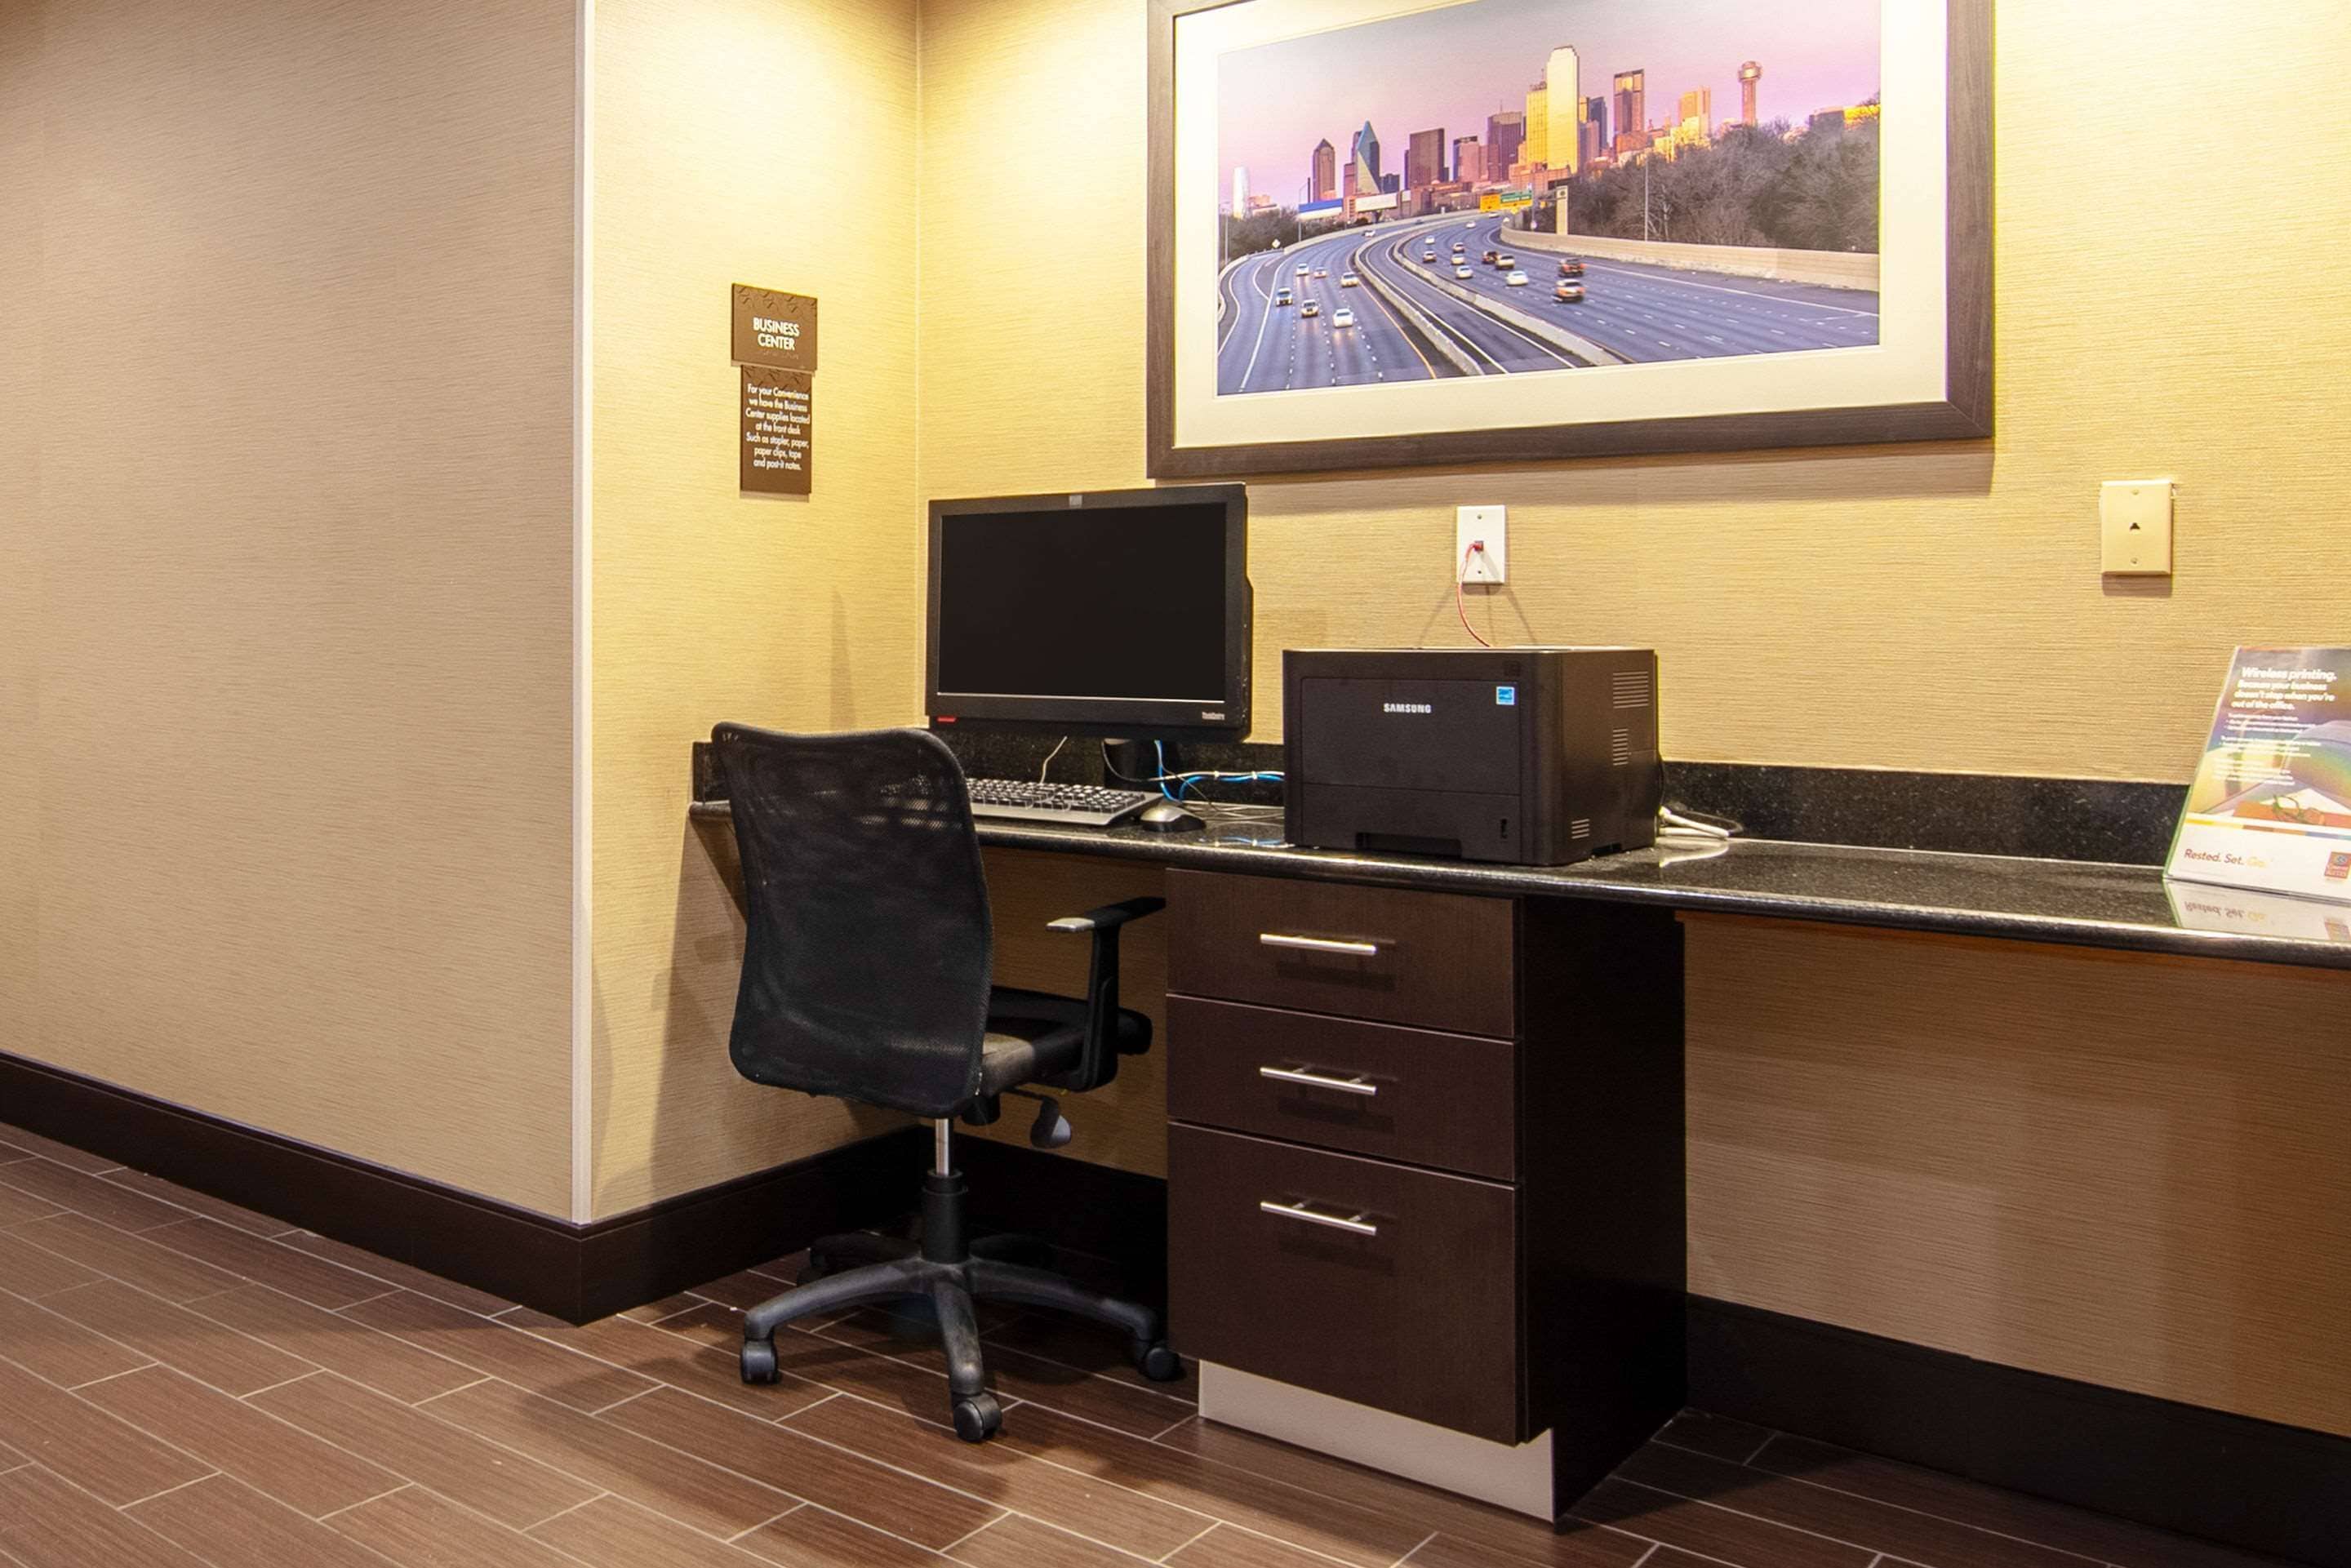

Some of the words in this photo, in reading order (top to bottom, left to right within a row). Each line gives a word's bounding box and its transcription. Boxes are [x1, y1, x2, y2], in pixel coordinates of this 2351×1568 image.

[753, 317, 800, 337] BUSINESS
[758, 332, 796, 351] CENTER
[747, 383, 758, 394] For
[758, 388, 772, 398] your
[749, 398, 758, 406] we
[758, 397, 774, 408] have
[774, 398, 784, 409] the
[744, 407, 765, 419] Center
[766, 411, 789, 423] supplies
[789, 411, 811, 424] located
[755, 421, 762, 431] at
[762, 420, 772, 432] the
[772, 422, 787, 433] front
[787, 424, 802, 435] desk
[745, 431, 761, 443] Such
[761, 436, 769, 444] as
[790, 439, 810, 450] paper,
[753, 447, 772, 457] paper
[789, 450, 802, 460] tape
[753, 457, 766, 468] and
[766, 460, 784, 471] post-it
[784, 462, 802, 471] notes.
[2242, 666, 2287, 679] Wireless
[2288, 668, 2337, 682] printing.
[2306, 692, 2335, 702] you're
[1383, 702, 1432, 713] SAMSUNG
[2184, 848, 2221, 863] Rested.
[2224, 853, 2245, 865] Set.
